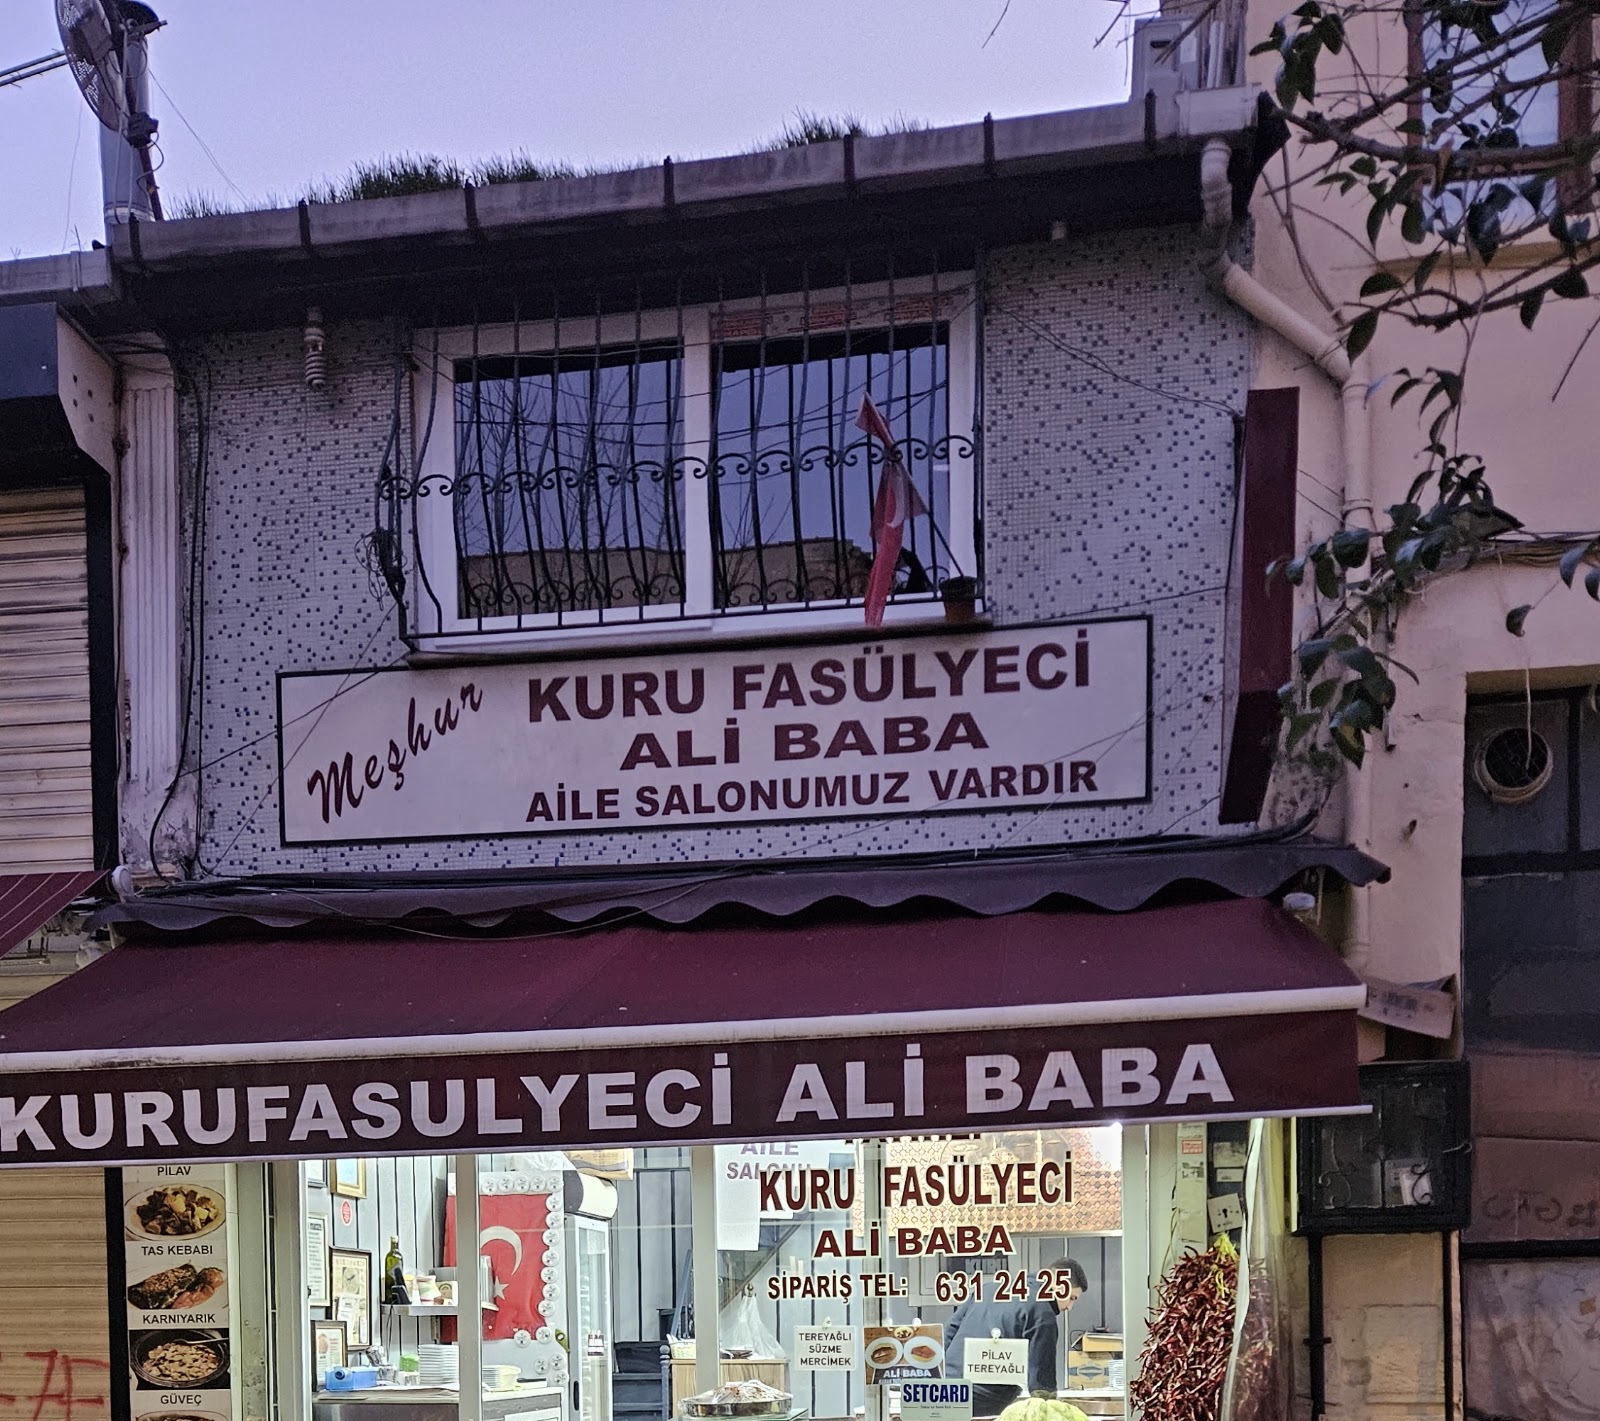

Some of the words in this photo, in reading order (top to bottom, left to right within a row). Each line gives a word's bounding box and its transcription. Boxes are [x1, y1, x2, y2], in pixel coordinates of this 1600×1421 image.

[528, 668, 705, 723] KURU
[732, 628, 1090, 711] FASÜLYECİ
[620, 717, 740, 771] ALİ
[774, 712, 990, 762] BABA
[307, 682, 483, 824] Meşhur
[525, 782, 620, 823] AİLE
[635, 771, 910, 818] SALONUMUZ
[928, 760, 1099, 801] VARDIR
[0, 1052, 731, 1153] KURUFASULYECİ
[775, 1043, 925, 1122] ALİ
[965, 1043, 1235, 1115] BABA
[759, 1168, 856, 1212] KURU
[884, 1150, 1073, 1207] FASÜLYECİ
[813, 1221, 880, 1258] ALİ
[897, 1224, 1014, 1257] BABA
[141, 1245, 164, 1256] TAS
[167, 1244, 213, 1256] KEBABI
[767, 1269, 853, 1304] SİPARİŞ
[859, 1273, 907, 1297] TEL:
[935, 1271, 982, 1302] 631
[994, 1270, 1028, 1302] 24
[1036, 1269, 1071, 1300] 25
[142, 1313, 216, 1325] KARNIYARIK
[798, 1330, 852, 1341] TEREYAĞLI
[808, 1343, 842, 1354] SÜZME
[981, 1349, 1012, 1360] PİLAV
[800, 1355, 851, 1366] MERCİMEK
[967, 1362, 1025, 1374] TEREYAĞLI
[882, 1365, 900, 1378] ALİ
[902, 1367, 932, 1378] BABA
[160, 1392, 202, 1405] GÜVEÇ
[903, 1383, 970, 1403] SETCARD
